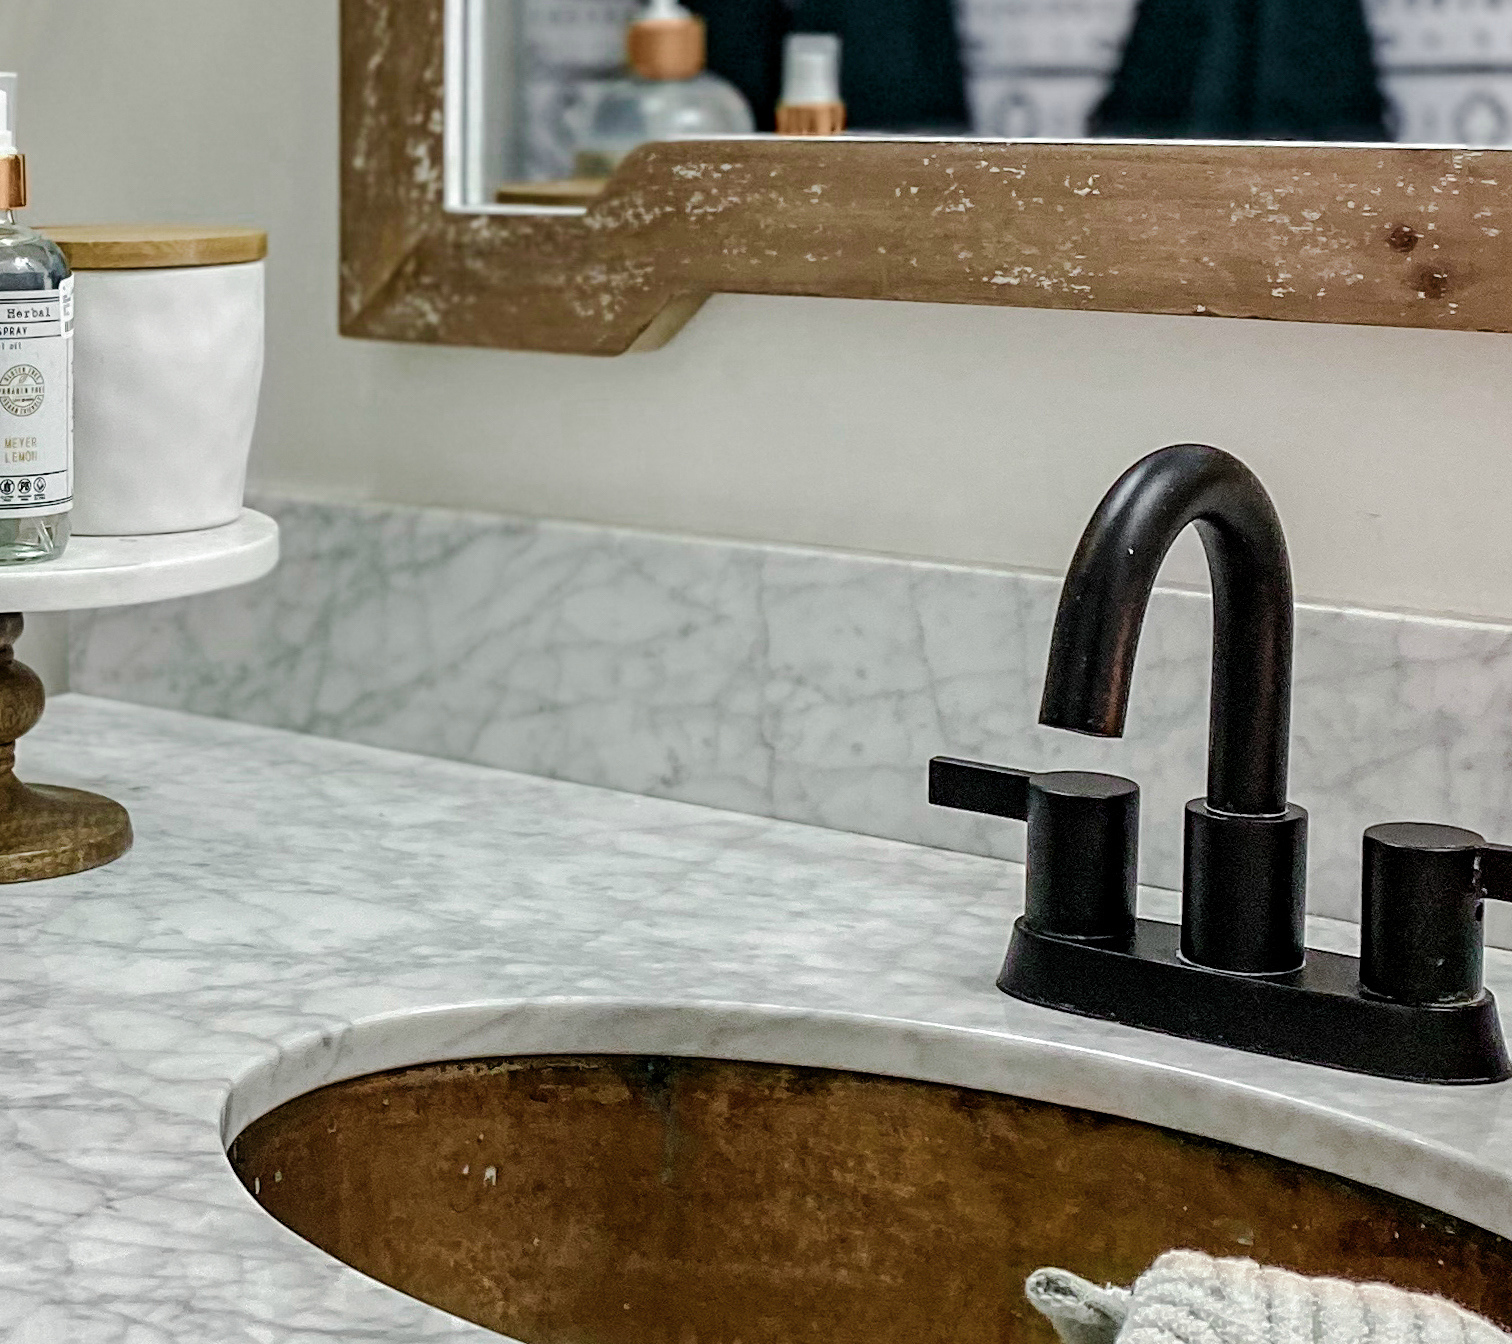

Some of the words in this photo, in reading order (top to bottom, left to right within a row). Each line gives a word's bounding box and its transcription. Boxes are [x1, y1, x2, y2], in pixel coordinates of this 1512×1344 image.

[7, 307, 51, 319] Herbal
[4, 437, 37, 448] MEYER
[4, 451, 37, 463] LEMON
